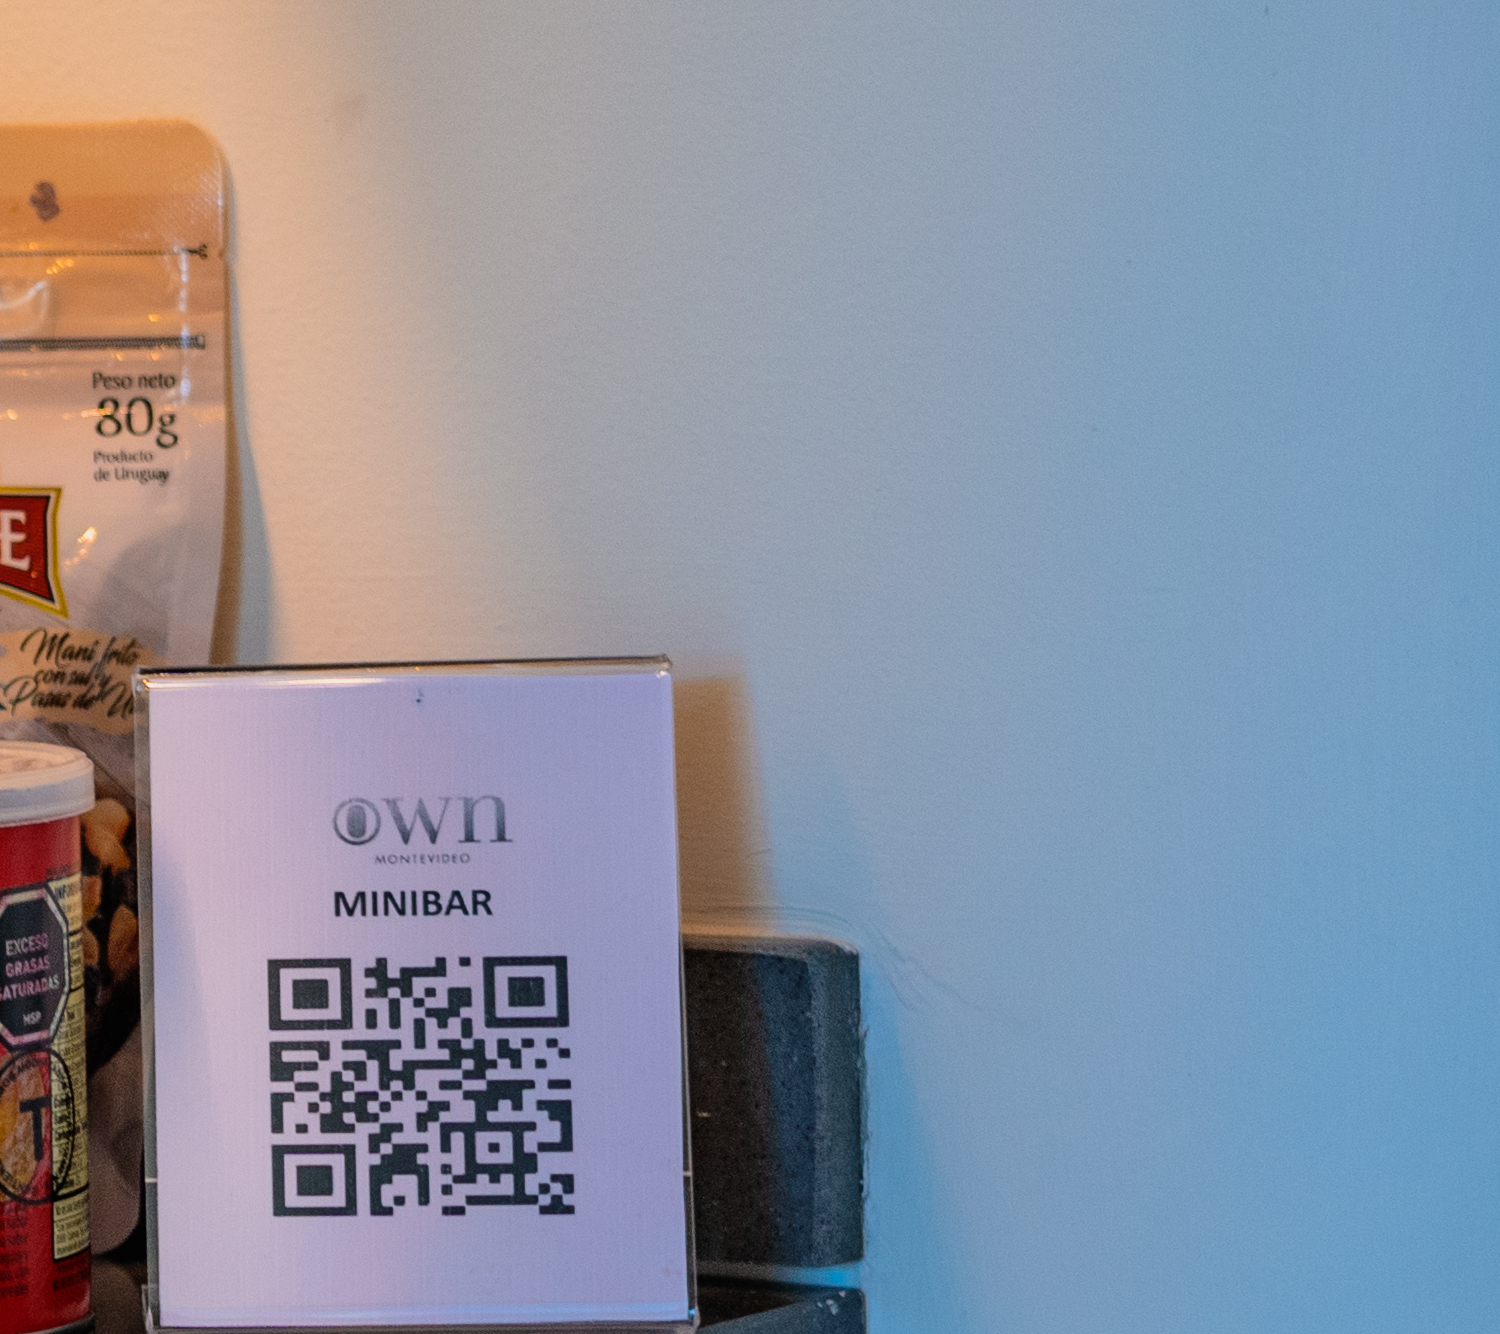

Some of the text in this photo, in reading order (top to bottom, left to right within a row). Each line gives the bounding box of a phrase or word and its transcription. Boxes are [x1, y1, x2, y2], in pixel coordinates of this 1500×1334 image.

[92, 371, 176, 389] Peso neto
[93, 450, 153, 464] Producto
[94, 468, 169, 485] de Uruguay
[374, 853, 471, 864] MONTEVIDEO
[334, 889, 493, 917] MINIBAR
[5, 932, 49, 957] EXCESO
[5, 955, 49, 977] GRASAS
[22, 1010, 42, 1026] MSP
